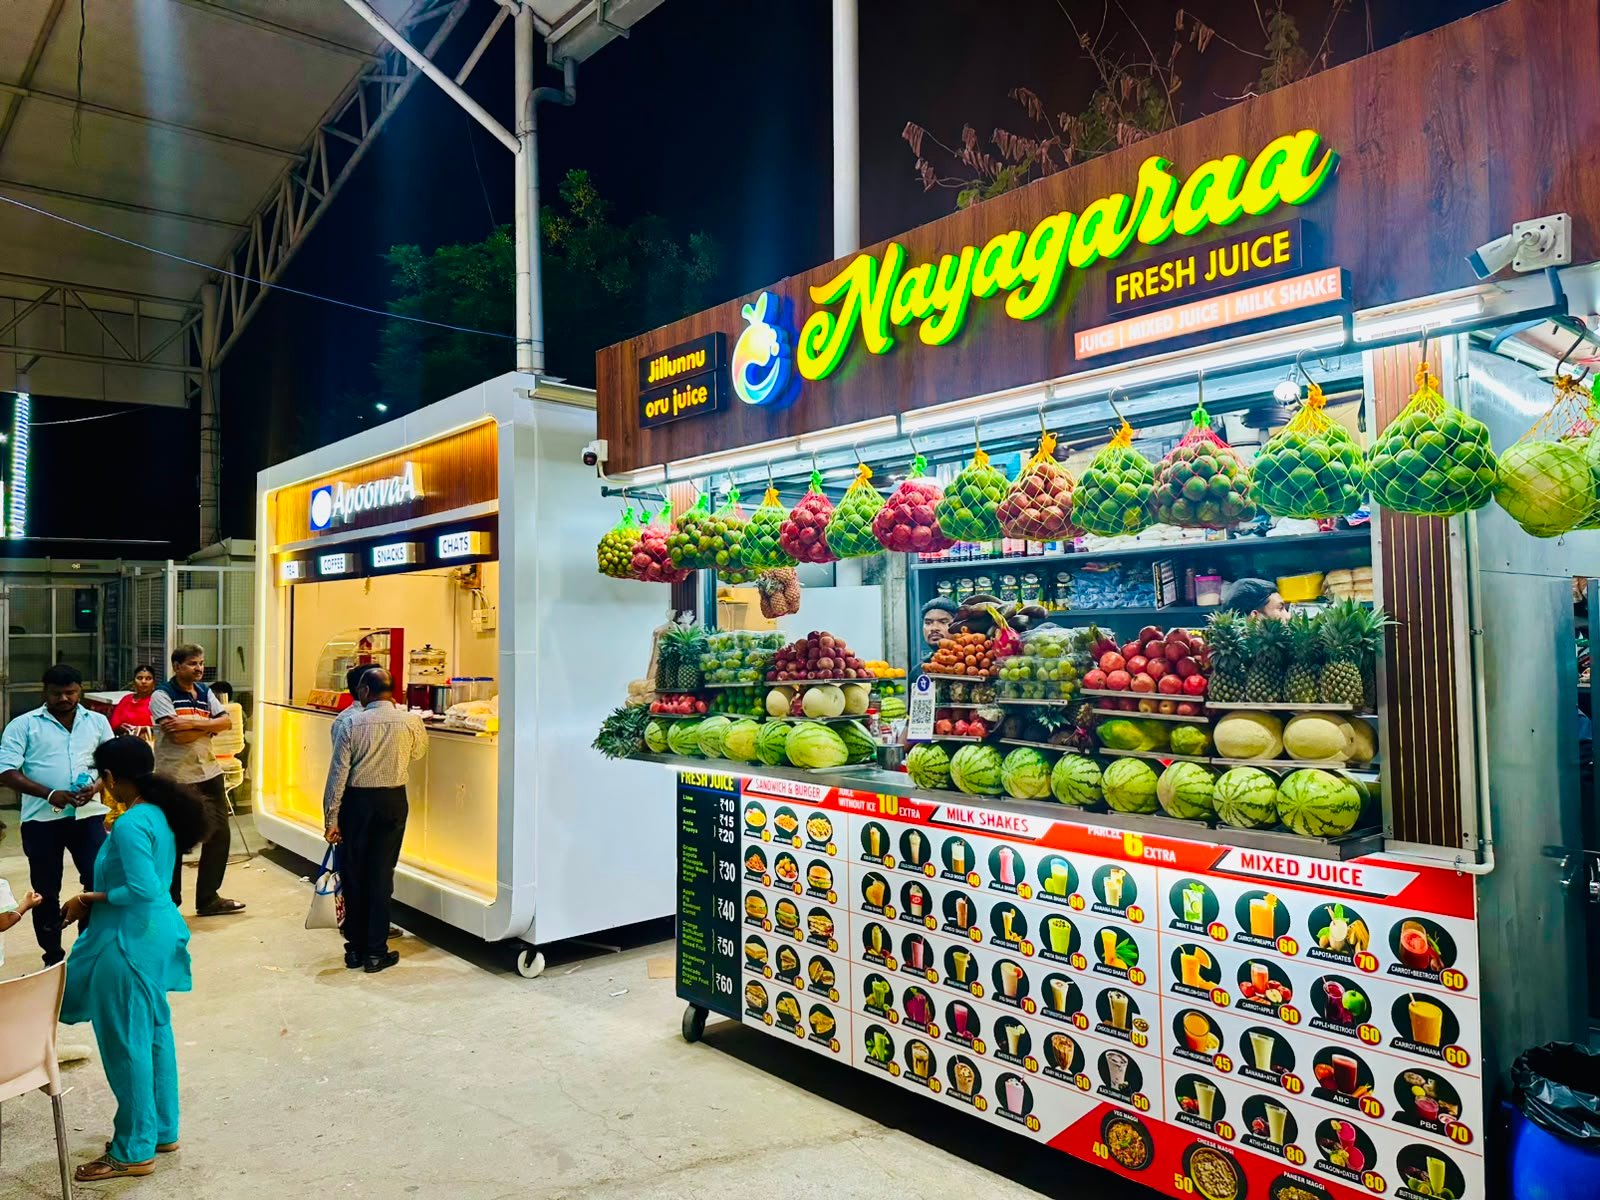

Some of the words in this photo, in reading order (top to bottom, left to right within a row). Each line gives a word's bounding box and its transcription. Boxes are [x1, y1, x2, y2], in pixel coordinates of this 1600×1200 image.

[797, 130, 1334, 380] Nayagaraa
[1115, 257, 1195, 304] FRESH
[1204, 231, 1290, 283] JUICE
[1079, 329, 1115, 353] JUICE
[1128, 310, 1174, 341] MIXED
[1177, 304, 1219, 332] JUICE
[1235, 287, 1275, 316] MILK
[1278, 274, 1337, 306] SHAKE
[648, 350, 706, 383] Jillunnu
[645, 397, 669, 418] oru
[673, 385, 708, 416] juice
[442, 536, 470, 554] CHATS
[378, 547, 404, 563] SNACKS
[323, 557, 345, 572] COFFEE
[681, 772, 708, 788] FRESH
[710, 775, 735, 792] JUICE
[755, 780, 788, 794] SANDWICH
[788, 787, 794, 795] &
[795, 786, 821, 799] BURGER
[719, 798, 735, 813] ₹10
[838, 797, 865, 811] WITHOUT
[866, 802, 877, 813] ICE
[877, 793, 899, 816] 10
[899, 807, 921, 820] EXTRA
[719, 813, 735, 828] ₹15
[947, 807, 974, 825] MILK
[979, 812, 1029, 833] SHAKES
[718, 827, 735, 843] ₹20
[1123, 829, 1144, 858] 6
[1144, 846, 1177, 863] EXTRA
[884, 857, 894, 867] 40
[719, 860, 736, 883] ₹30
[924, 865, 934, 876] 40
[1241, 854, 1300, 878] MIXED
[1307, 863, 1364, 887] JUICE
[968, 874, 980, 887] 40
[1018, 884, 1032, 900] 50
[1053, 895, 1067, 903] SHAKE
[717, 898, 735, 922] ₹40
[1069, 895, 1084, 910] 60
[1111, 907, 1125, 916] SHAKE
[1128, 907, 1144, 922] 60
[926, 917, 935, 928] 60
[1176, 921, 1190, 930] MINT
[1191, 924, 1204, 933] LIME
[970, 929, 980, 941] 60
[1211, 926, 1226, 940] 40
[717, 936, 734, 958] ₹50
[829, 940, 837, 951] 50
[1020, 940, 1032, 955] 60
[1279, 939, 1296, 954] 60
[1072, 955, 1085, 968] 60
[1311, 949, 1352, 963] SAPOTA+DATES
[1356, 953, 1375, 970] 70
[928, 970, 937, 982] 60
[1096, 965, 1112, 974] MANGO
[1112, 968, 1126, 977] SHAKE
[1129, 970, 1144, 983] 60
[1391, 965, 1439, 981] CARROT+BEETROOT
[716, 973, 733, 994] ₹60
[1443, 972, 1463, 988] 60
[972, 984, 982, 996] 60
[1213, 990, 1228, 1005] 60
[1024, 1000, 1035, 1012] 70
[1241, 1003, 1274, 1016] CARROT+APPLE
[889, 1011, 897, 1022] 70
[1076, 1015, 1086, 1028] 70
[1281, 1007, 1298, 1023] 60
[929, 1025, 938, 1036] 70
[1096, 1025, 1117, 1037] CHOCOLATE
[1312, 1020, 1356, 1036] APPLE+BEETROOT
[1361, 1026, 1379, 1042] 60
[974, 1040, 984, 1053] 80
[1132, 1035, 1146, 1047] 60
[1394, 1040, 1441, 1057] CARROT+BANANA
[1215, 1056, 1230, 1071] 45
[1446, 1048, 1466, 1065] 60
[1026, 1058, 1037, 1071] 80
[930, 1079, 940, 1091] 80
[1077, 1076, 1089, 1089] 50
[1285, 1076, 1300, 1092] 70
[975, 1096, 985, 1109] 80
[1134, 1095, 1148, 1110] 50
[1333, 1094, 1350, 1105] ABC
[1363, 1099, 1379, 1115] 70
[1027, 1117, 1038, 1130] 80
[1113, 1109, 1122, 1118] VEG
[1123, 1112, 1139, 1123] MAGGI
[1180, 1115, 1212, 1131] APPLE+DATES
[1220, 1124, 1232, 1138] 70
[1420, 1120, 1437, 1131] PBC
[1452, 1125, 1467, 1142] 70
[1092, 1141, 1109, 1160] 40
[1196, 1137, 1217, 1149] CHEESE
[1217, 1143, 1235, 1155] MAGGI
[1287, 1147, 1303, 1163] 80
[1318, 1162, 1359, 1181] DRAGON+DATES
[1173, 1172, 1194, 1194] 50
[1284, 1171, 1305, 1185] PANEER
[1305, 1178, 1326, 1191] MAGGI
[1365, 1174, 1384, 1191] 80
